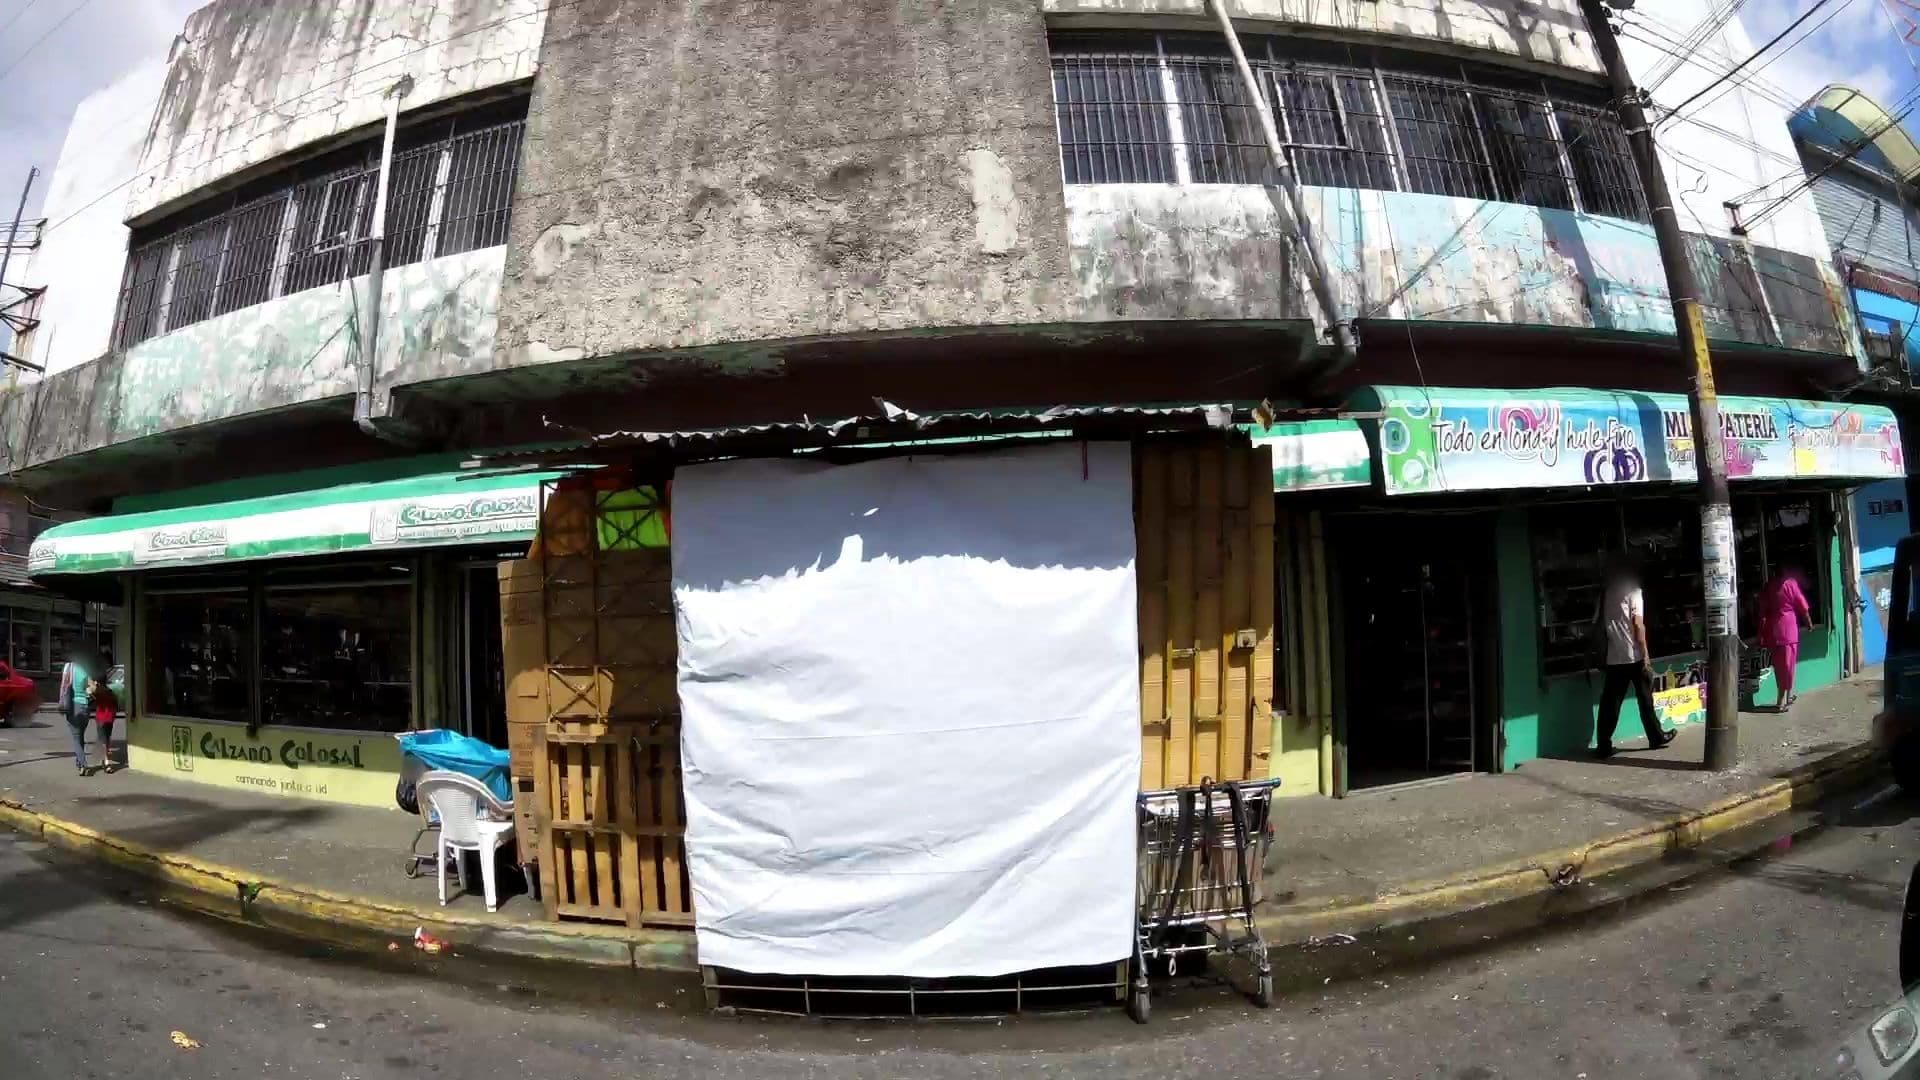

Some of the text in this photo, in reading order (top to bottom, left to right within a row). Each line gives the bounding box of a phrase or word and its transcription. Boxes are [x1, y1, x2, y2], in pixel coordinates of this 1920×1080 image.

[1432, 421, 1474, 452] Todo
[1481, 430, 1502, 451] en
[1566, 420, 1602, 449] hule
[1663, 411, 1688, 437] MI
